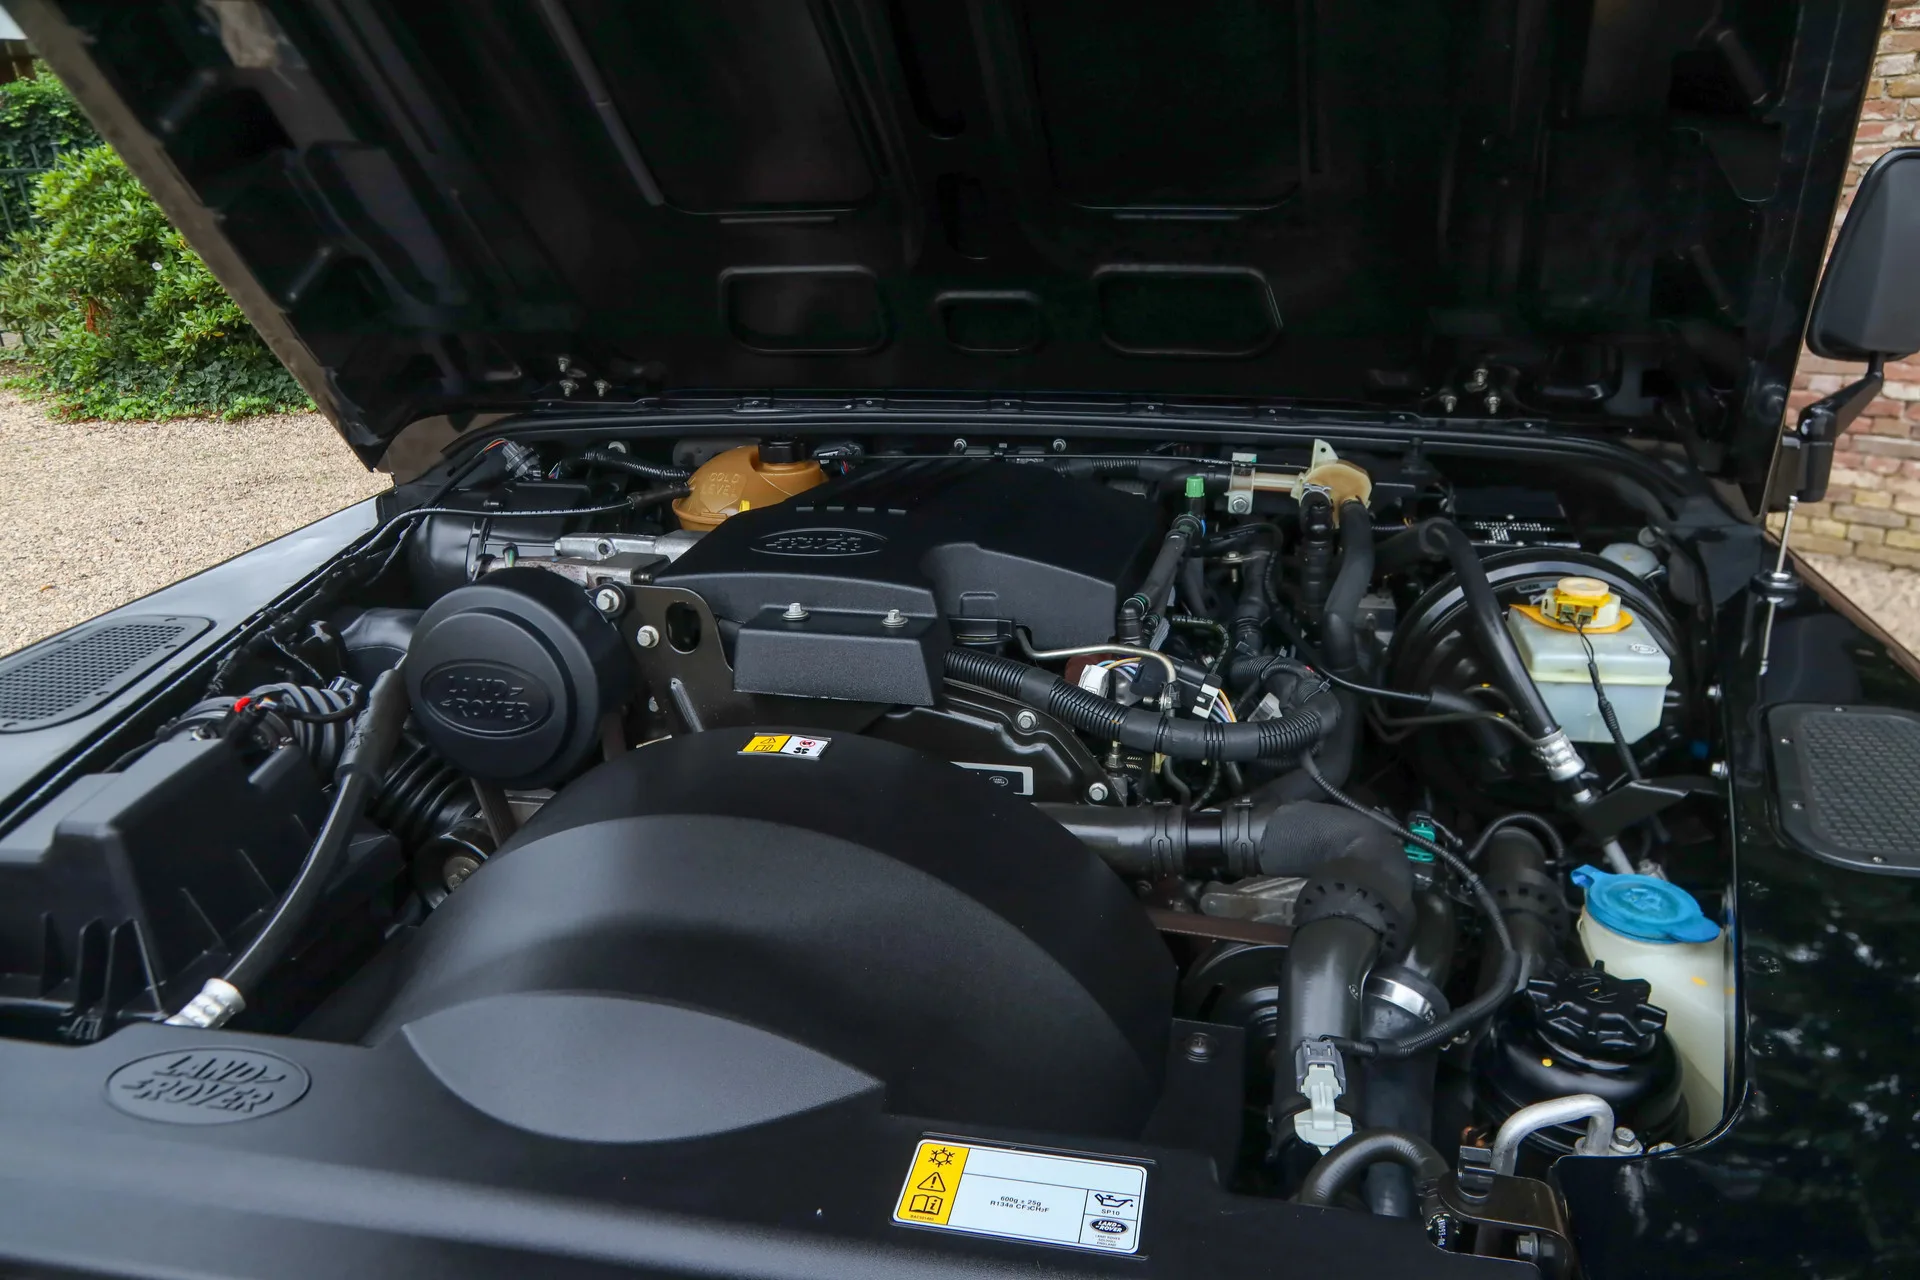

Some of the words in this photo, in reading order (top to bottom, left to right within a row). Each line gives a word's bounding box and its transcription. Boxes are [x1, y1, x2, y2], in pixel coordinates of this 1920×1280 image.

[153, 1055, 279, 1085] LAND
[124, 1078, 275, 1114] ROVER
[1000, 1195, 1019, 1204] 600g
[1027, 1199, 1042, 1207] 25g
[1097, 1220, 1119, 1228] LAND
[1098, 1225, 1122, 1233] ROVER
